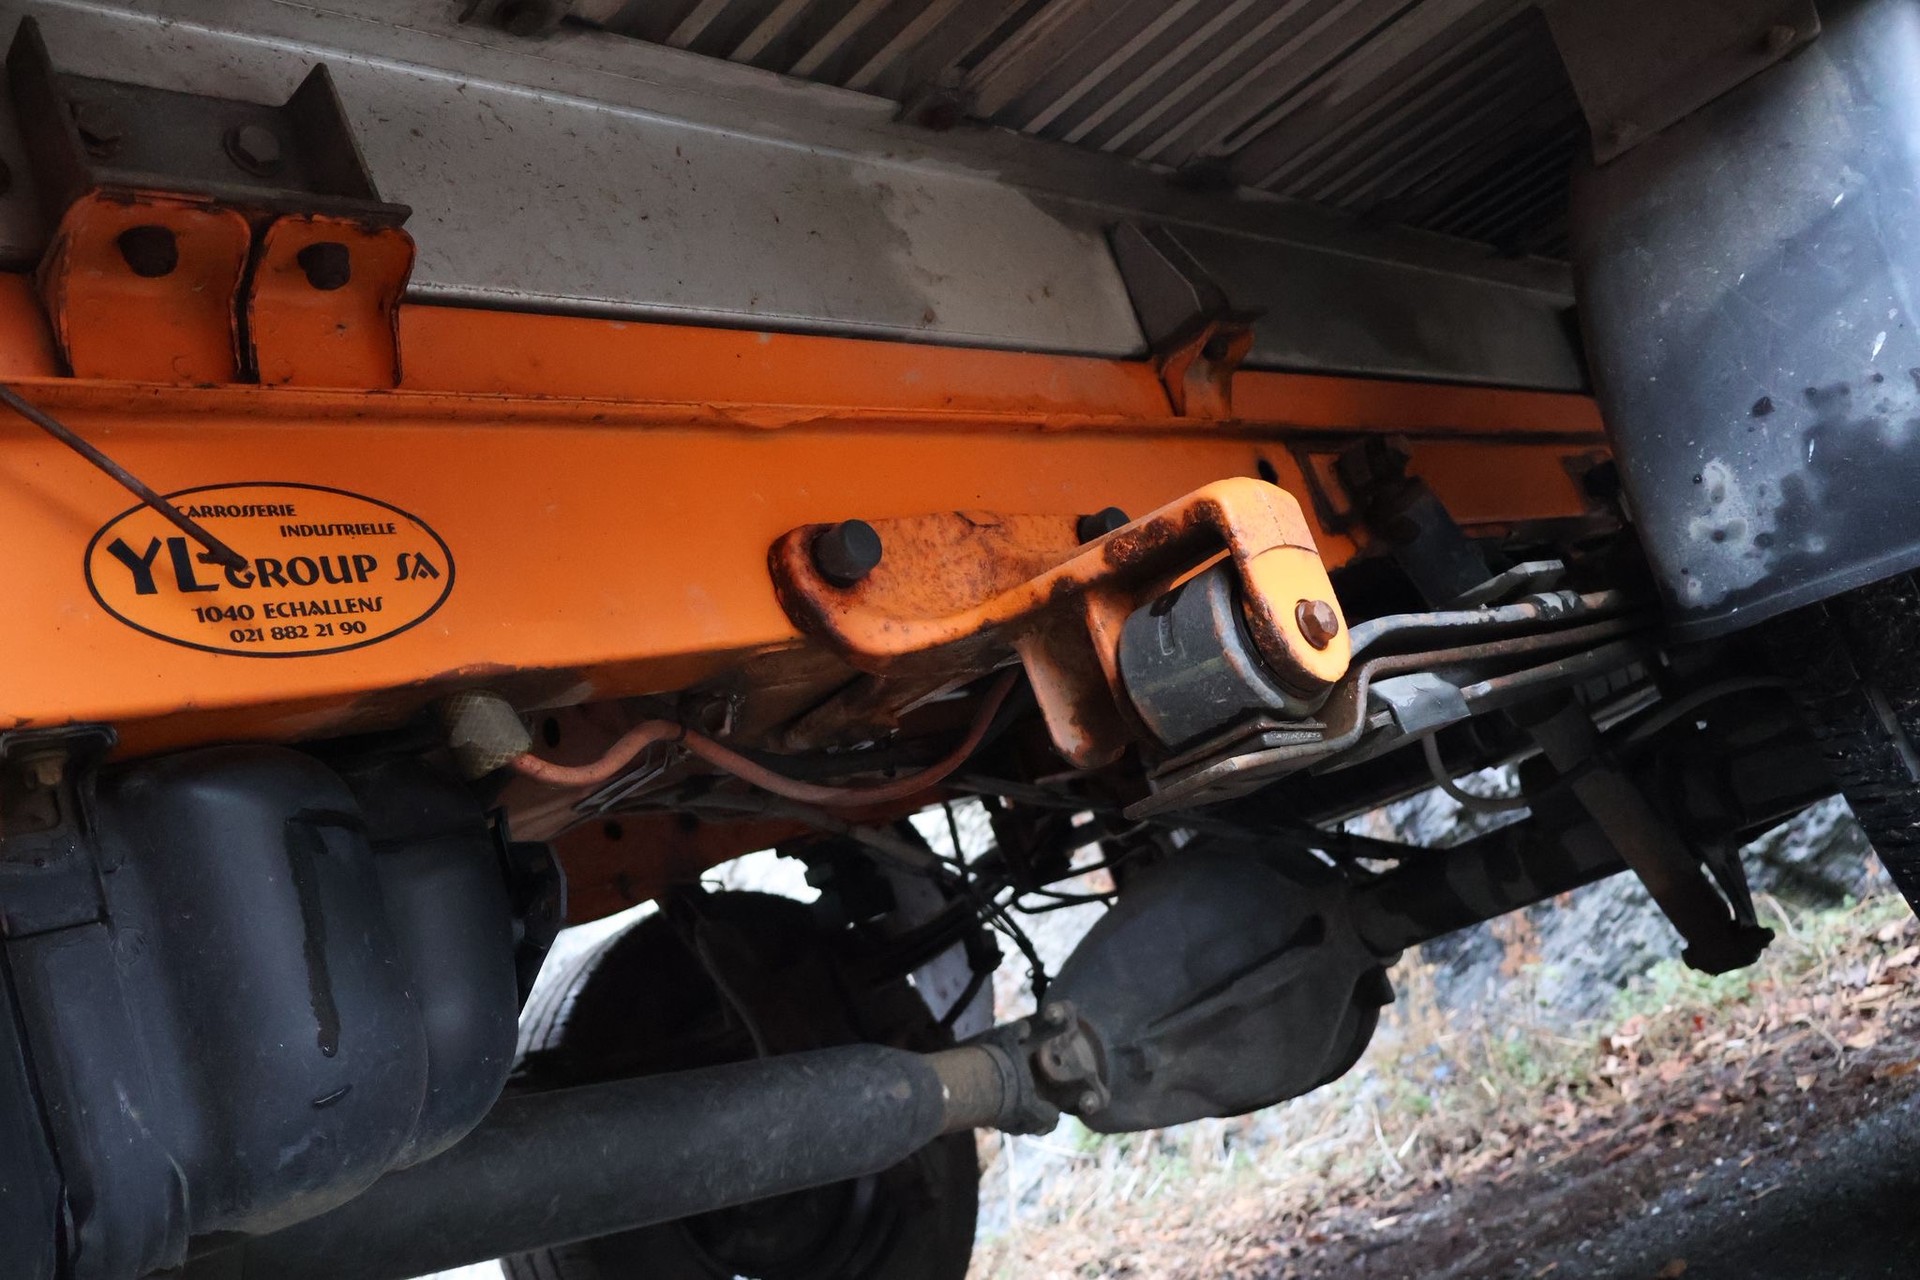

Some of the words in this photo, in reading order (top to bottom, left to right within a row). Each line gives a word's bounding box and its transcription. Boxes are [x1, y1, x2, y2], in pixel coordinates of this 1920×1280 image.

[281, 523, 396, 537] INDUSTRIELLE
[224, 554, 377, 588] GROUP
[395, 552, 440, 581] SA
[192, 604, 255, 623] 1040
[265, 597, 382, 618] ECHALLENS
[230, 628, 264, 643] 021
[271, 625, 308, 640] 882
[315, 623, 334, 638] 21
[340, 621, 367, 636] 90
